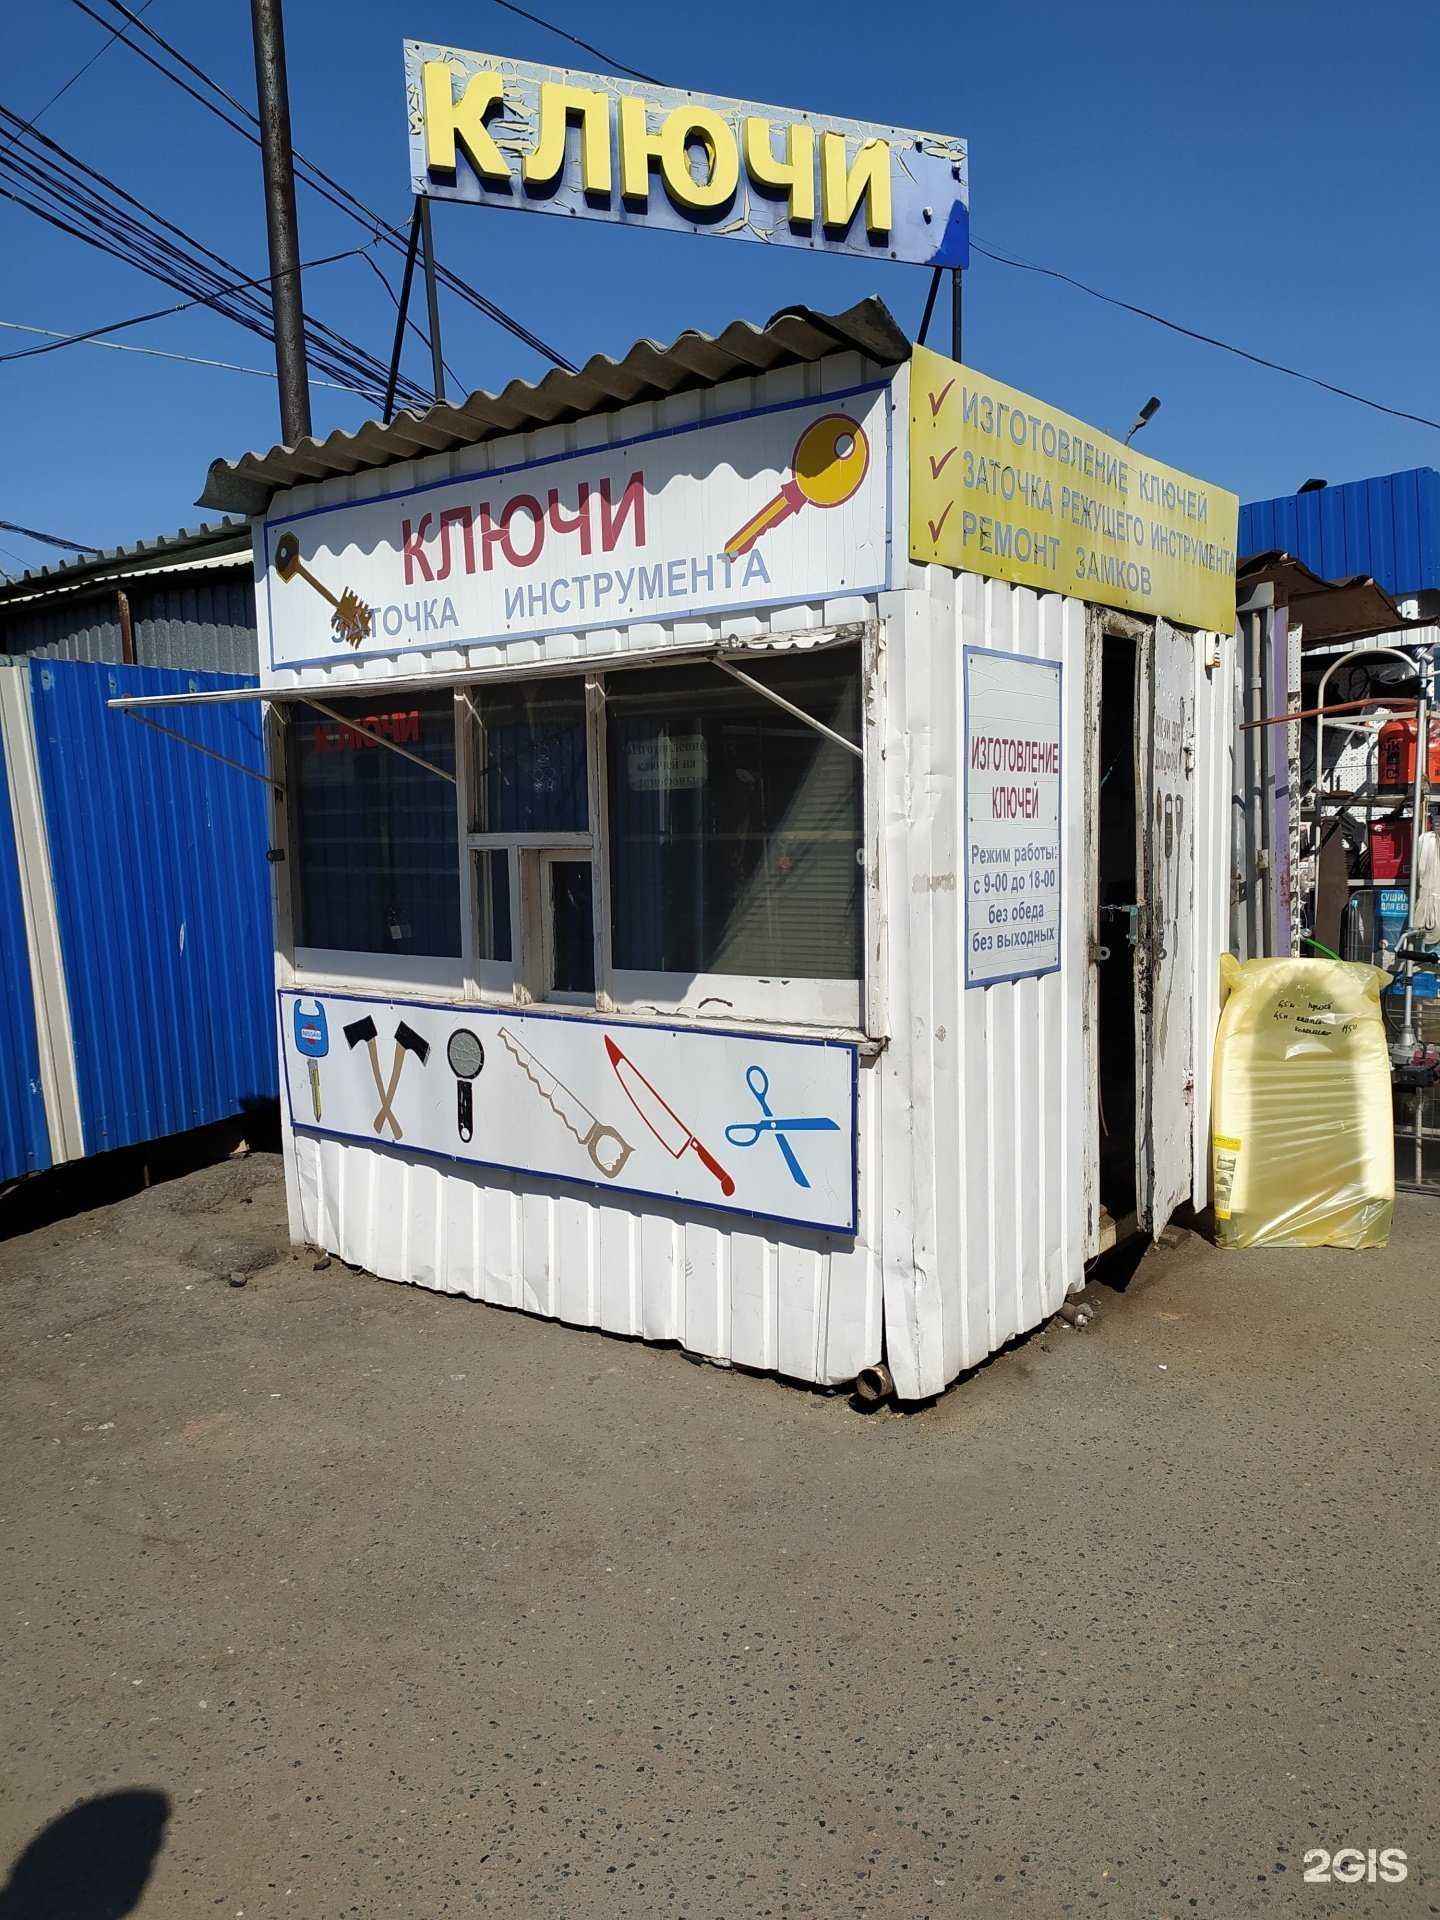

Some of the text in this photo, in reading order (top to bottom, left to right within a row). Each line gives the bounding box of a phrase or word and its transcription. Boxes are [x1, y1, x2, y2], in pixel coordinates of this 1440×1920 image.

[424, 60, 892, 233] КЛЮЧИ
[962, 387, 1208, 524] ИЗГОТОВЛЕНИЕ КЛЮЧЕЙ
[401, 470, 647, 586] КЛЮЧИ
[962, 450, 1235, 577] ЗАТОЧКА РЕЖУЩЕГО ИНСТРУМЕНТА
[962, 511, 1153, 596] РЕМОНТ ЗАМКОВ
[504, 549, 771, 621] ИНСТРУМЕНТА
[971, 736, 1059, 774] ИЗГОТОВЛЕНИЕ
[992, 780, 1039, 819] КЛЮЧЕЙ
[971, 842, 1057, 866] Режим работы:
[973, 869, 1056, 894] с 9-00 до 18-00
[972, 927, 1055, 952] без выходных
[988, 901, 1044, 924] без обеда
